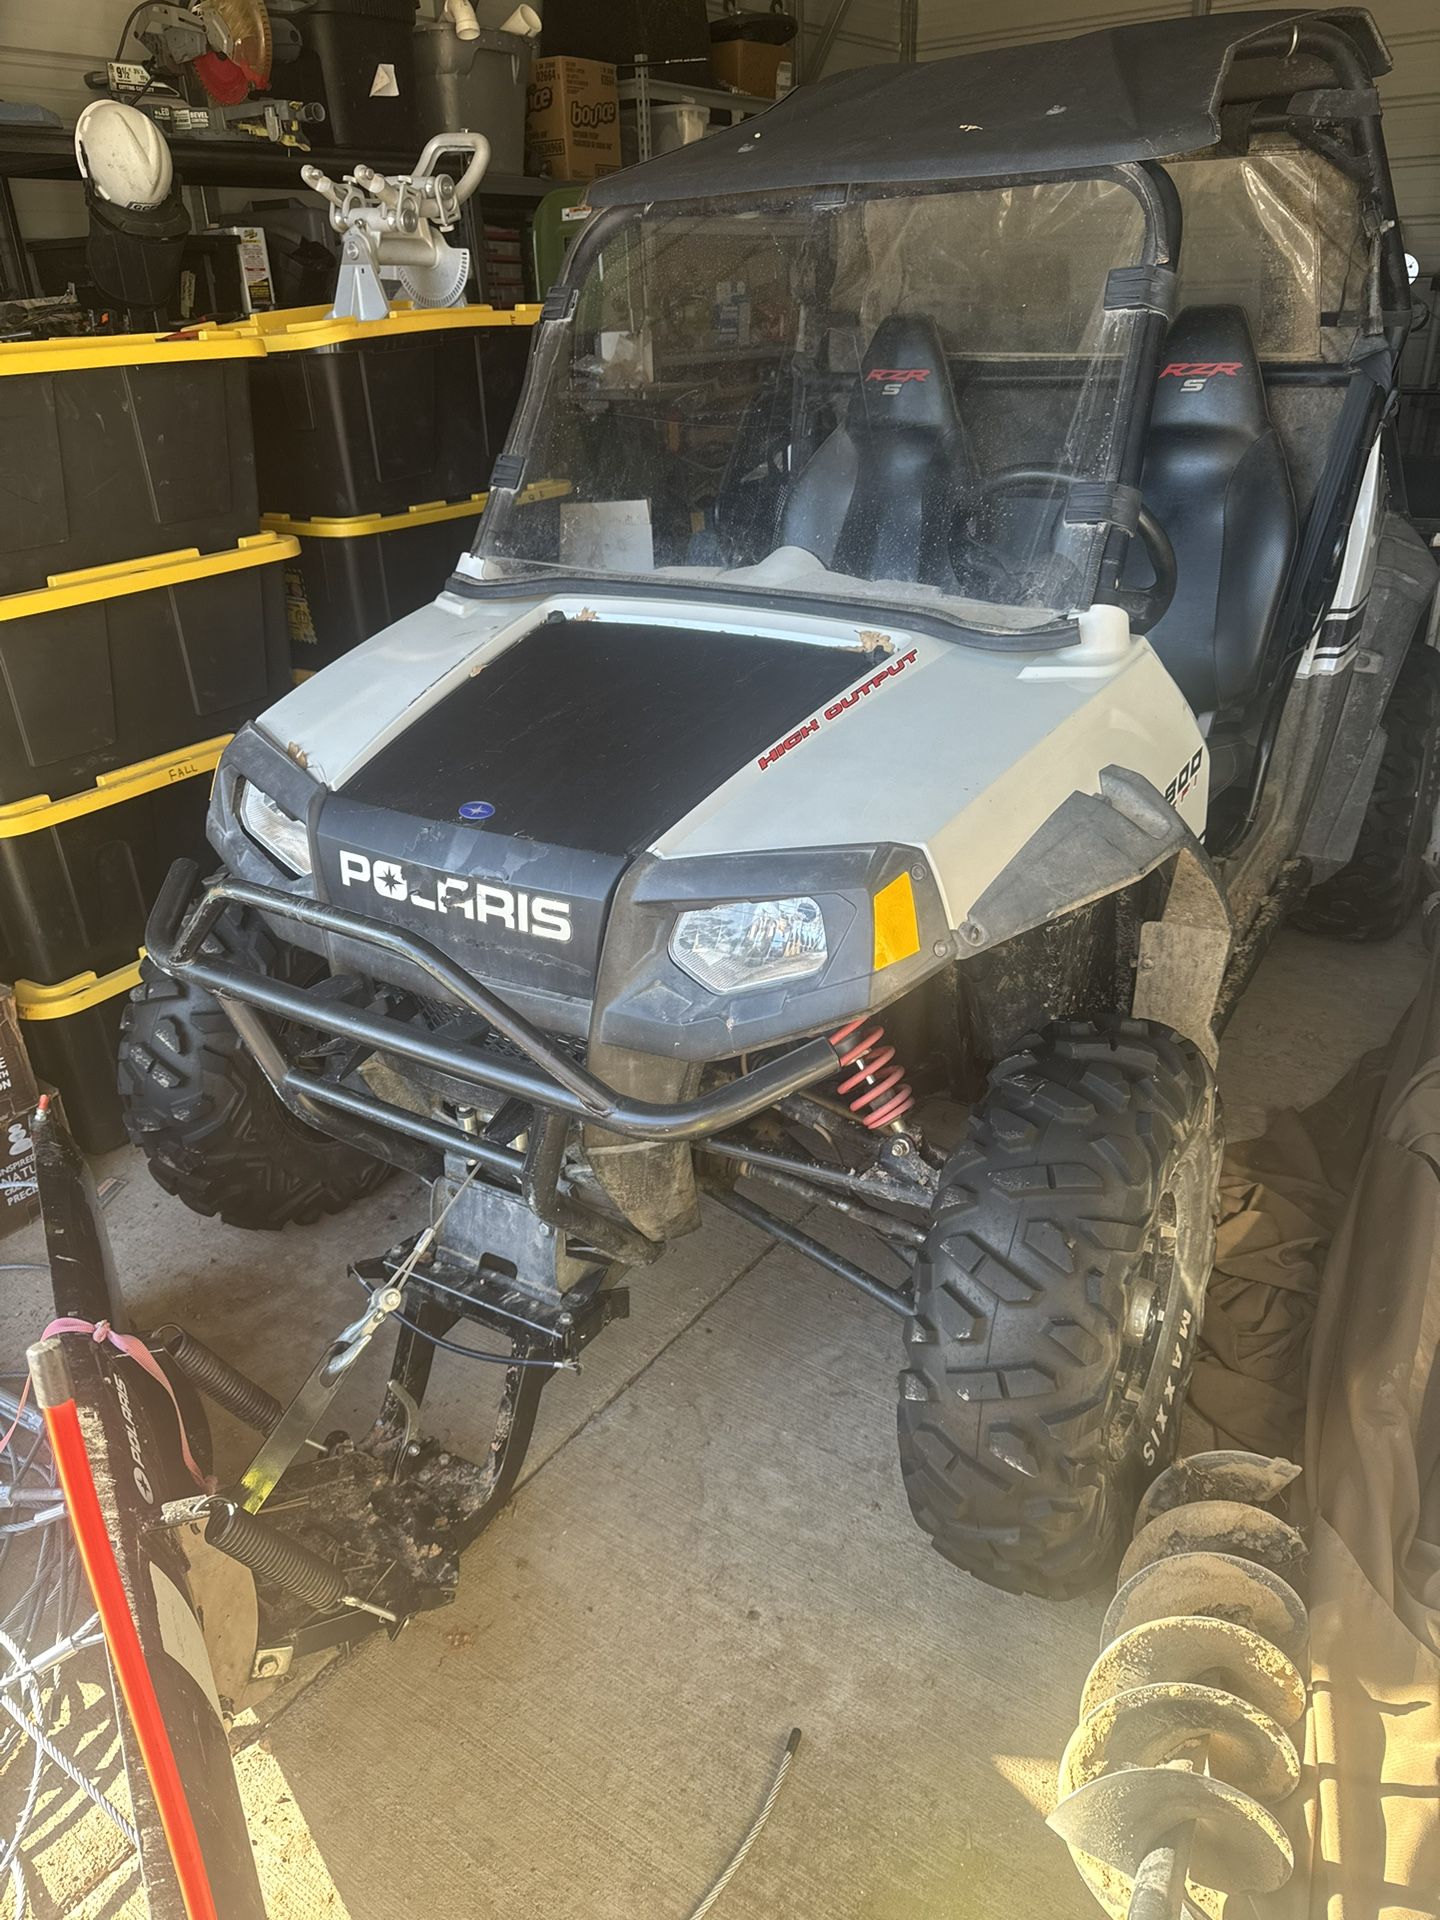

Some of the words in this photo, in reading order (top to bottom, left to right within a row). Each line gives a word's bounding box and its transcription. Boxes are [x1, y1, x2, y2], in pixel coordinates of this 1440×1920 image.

[571, 101, 616, 128] bounce
[864, 369, 932, 383] RZR
[1158, 362, 1244, 379] RZR
[882, 383, 903, 396] S
[1180, 378, 1208, 393] S
[757, 718, 821, 772] HIGH
[823, 648, 918, 721] OUTPUT
[168, 764, 199, 782] FALL
[339, 850, 573, 943] POLARIS
[1143, 1308, 1193, 1467] MAXXIS
[113, 1372, 145, 1470] POLARIS
